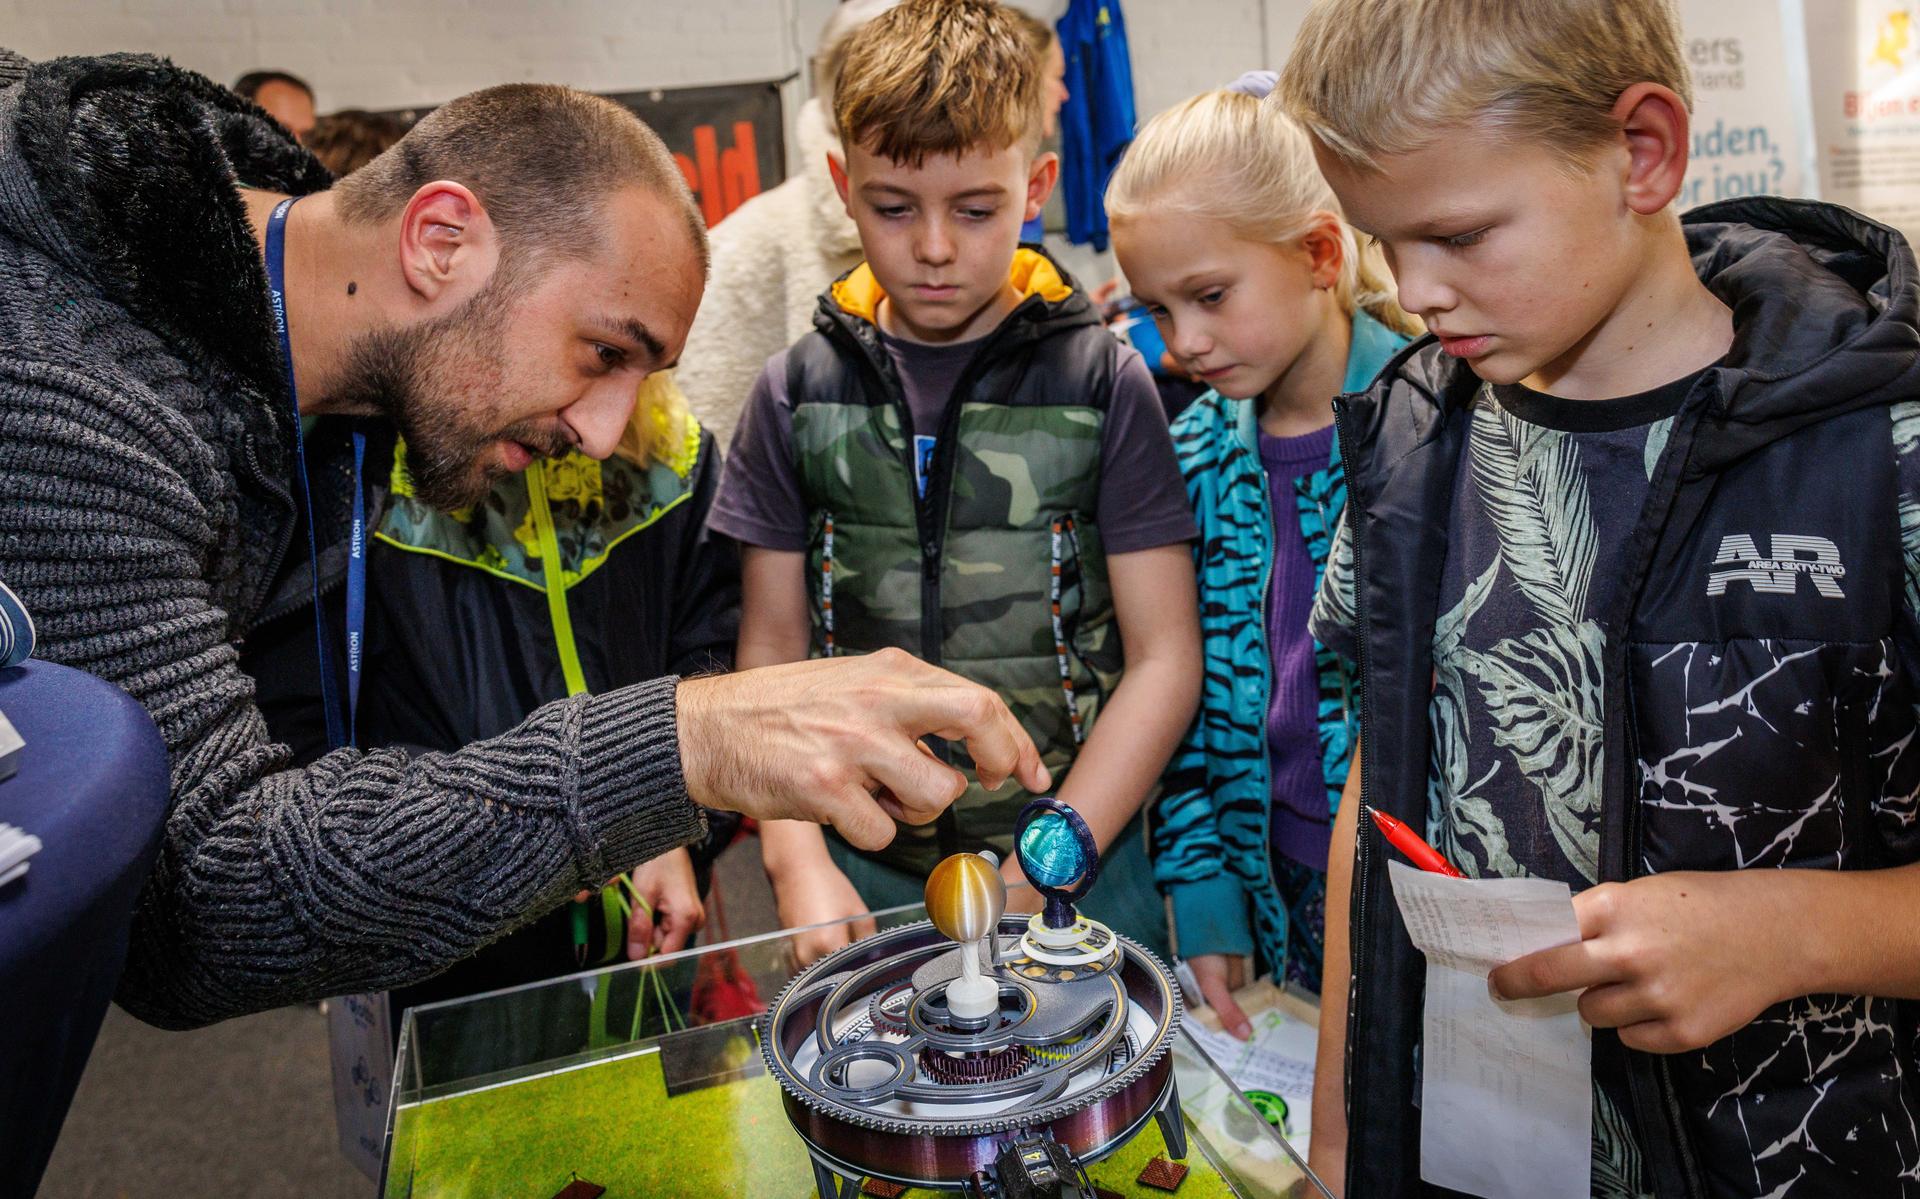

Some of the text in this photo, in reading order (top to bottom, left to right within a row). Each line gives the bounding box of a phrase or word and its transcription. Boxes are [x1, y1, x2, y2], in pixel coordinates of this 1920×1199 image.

[673, 121, 761, 229] ld
[271, 290, 285, 333] ASTRON
[352, 519, 361, 558] ASTRON
[1748, 560, 1846, 576] AREA SIXTY-TWO
[351, 631, 359, 673] ASTRON
